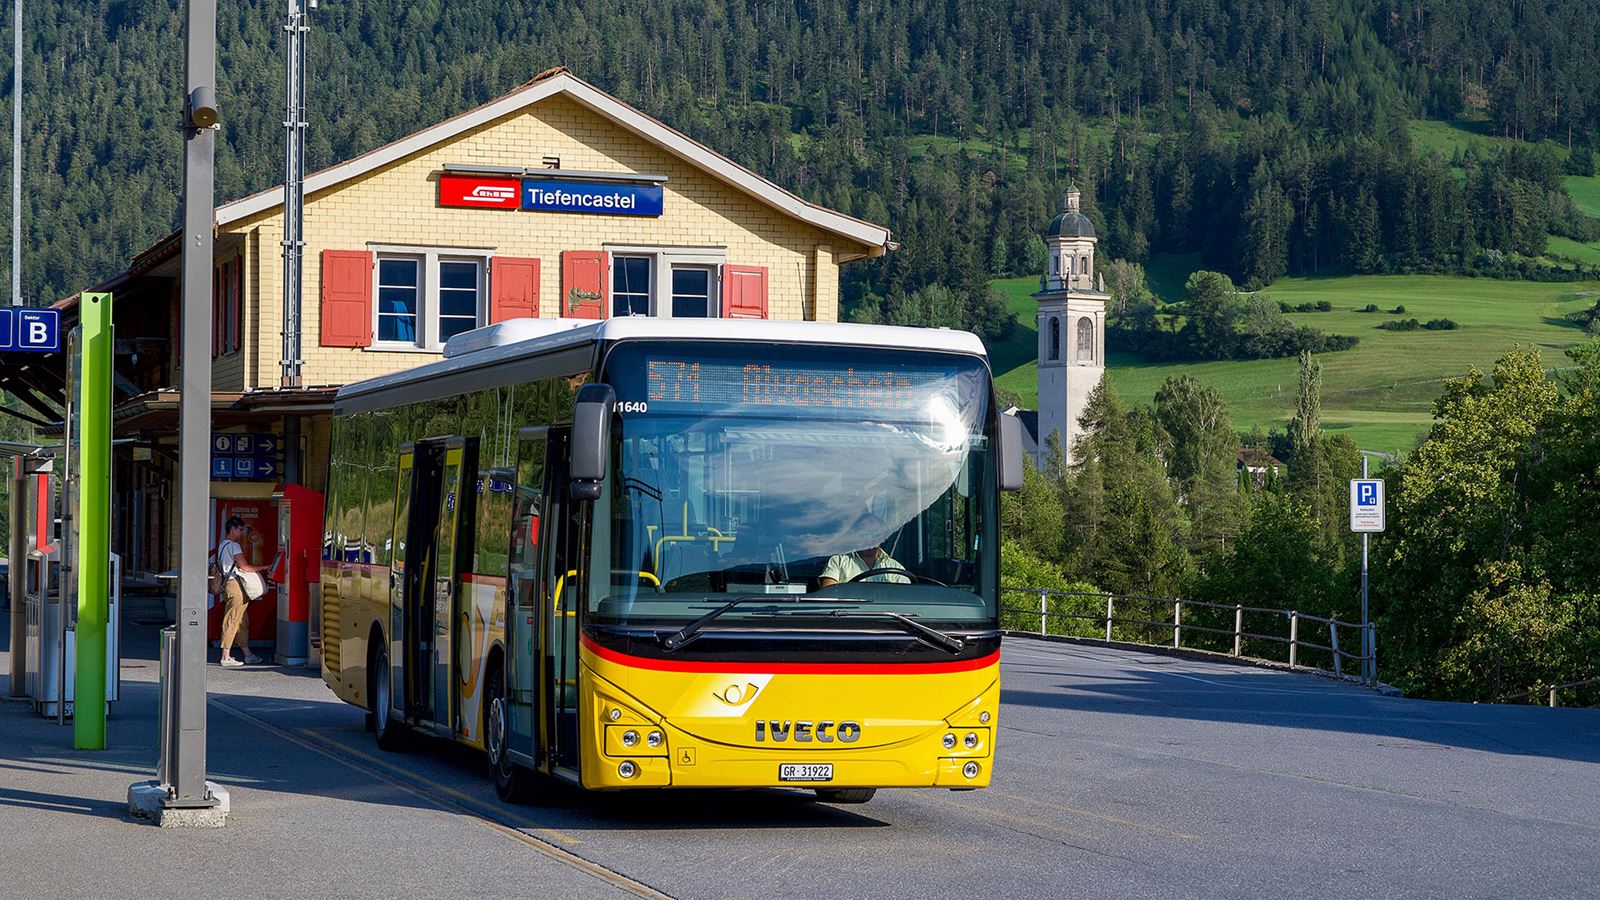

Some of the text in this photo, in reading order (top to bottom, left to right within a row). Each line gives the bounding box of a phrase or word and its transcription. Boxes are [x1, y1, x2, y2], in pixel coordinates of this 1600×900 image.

[528, 188, 636, 209] Tiefencastel
[29, 321, 48, 344] B
[648, 360, 701, 402] 571
[1361, 484, 1373, 503] P
[755, 720, 861, 742] IVECO
[783, 766, 830, 777] GR 31922
